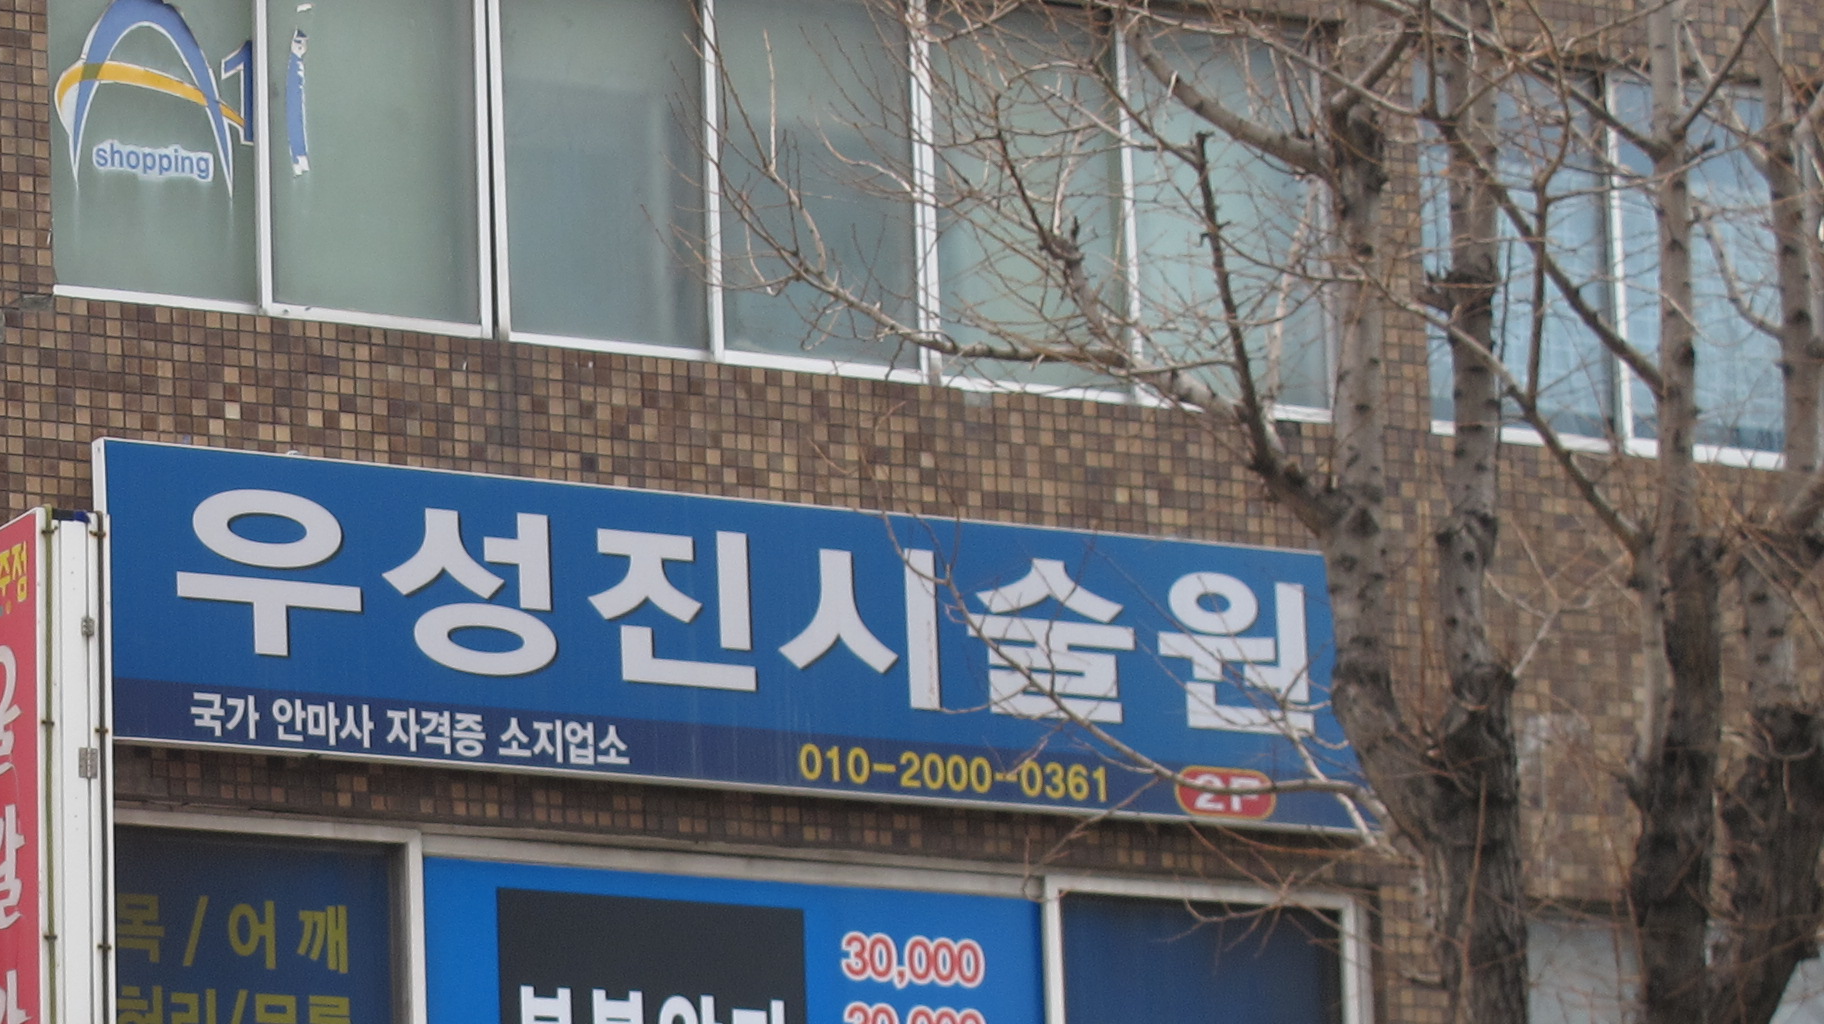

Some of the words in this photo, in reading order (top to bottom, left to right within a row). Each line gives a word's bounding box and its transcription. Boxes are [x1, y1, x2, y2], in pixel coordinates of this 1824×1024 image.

[94, 146, 210, 180] shopping
[177, 489, 1316, 735] 우성진시술원
[190, 692, 259, 739] 국가
[272, 699, 374, 748] 안마사
[386, 707, 486, 757] 자격증
[499, 720, 630, 765] 소지업소
[800, 744, 1109, 802] 010-2000-0361
[842, 932, 985, 988] 30,000
